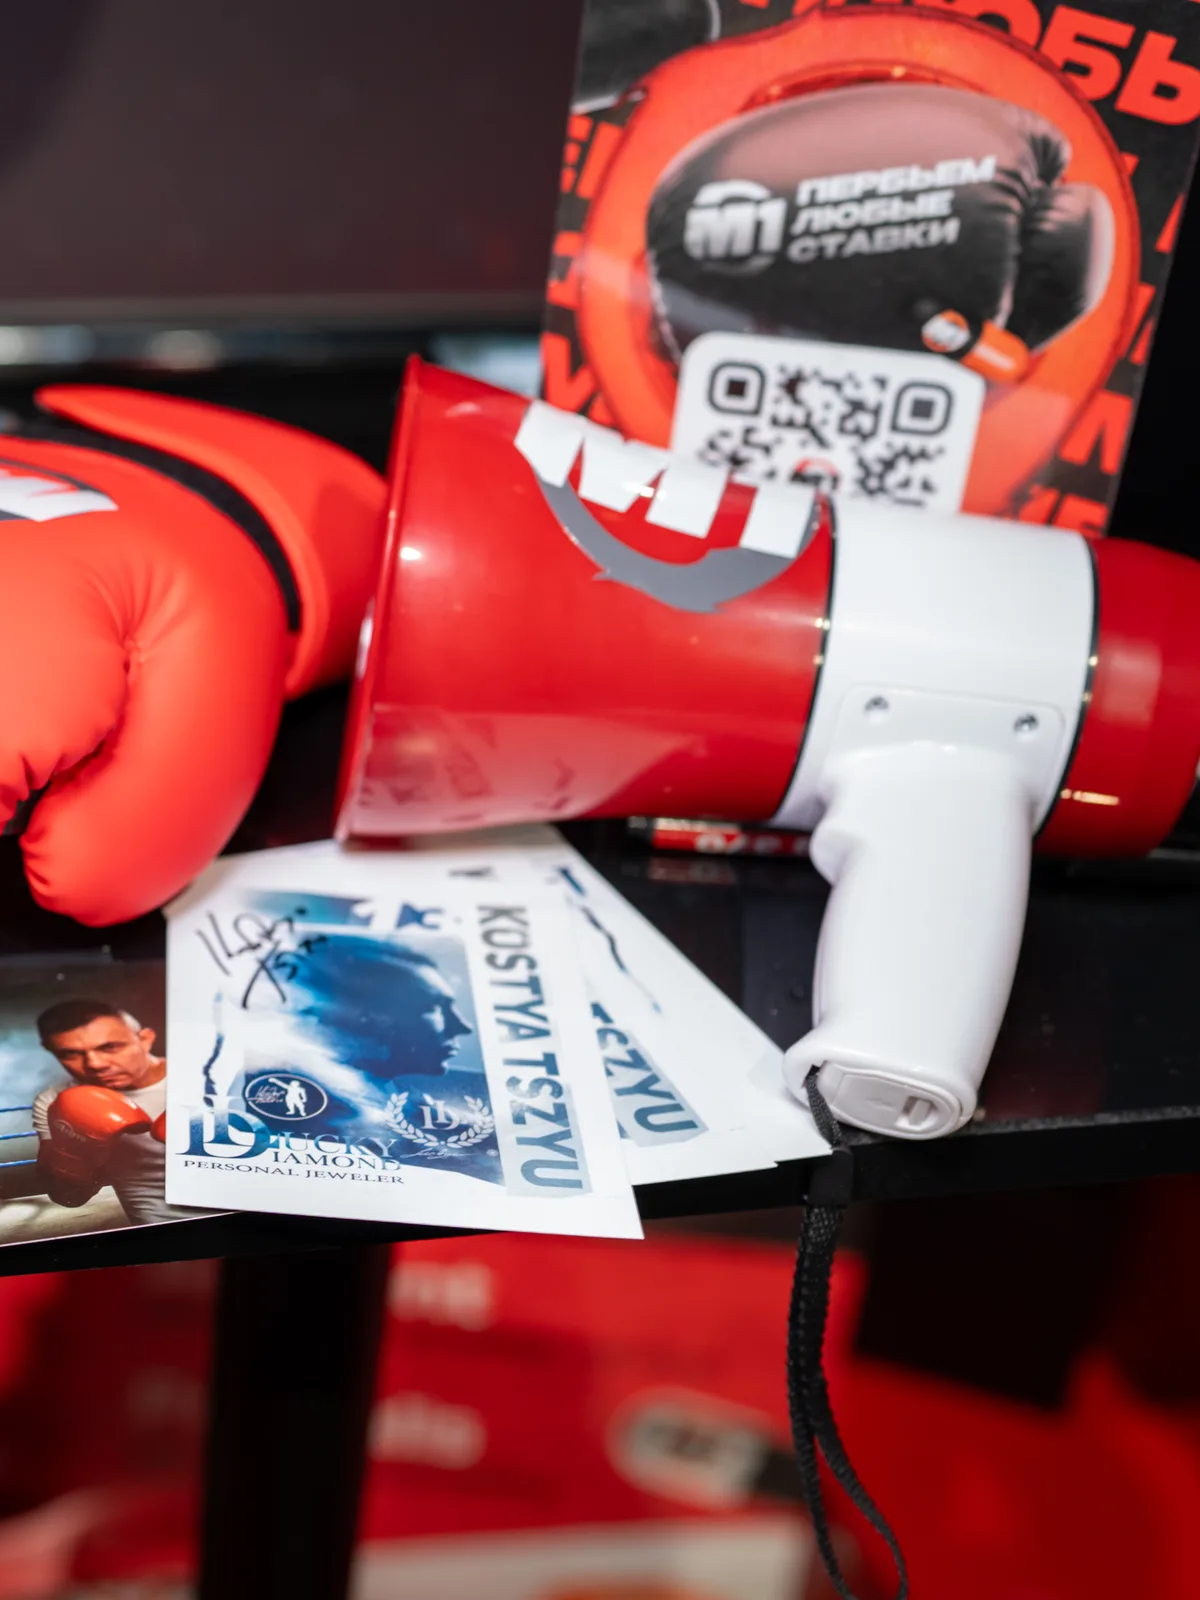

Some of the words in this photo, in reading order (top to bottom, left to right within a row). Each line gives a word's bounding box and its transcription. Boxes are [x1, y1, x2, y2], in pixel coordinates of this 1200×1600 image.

[684, 190, 787, 262] M1
[786, 217, 960, 263] СТАВКИ
[790, 189, 955, 236] ЛЮБЫЕ
[513, 400, 815, 559] M1
[476, 904, 552, 1043] KOSTYA
[502, 1052, 584, 1190] TSZYU
[184, 1160, 299, 1177] PERSONAL
[305, 1169, 404, 1184] JEWELER
